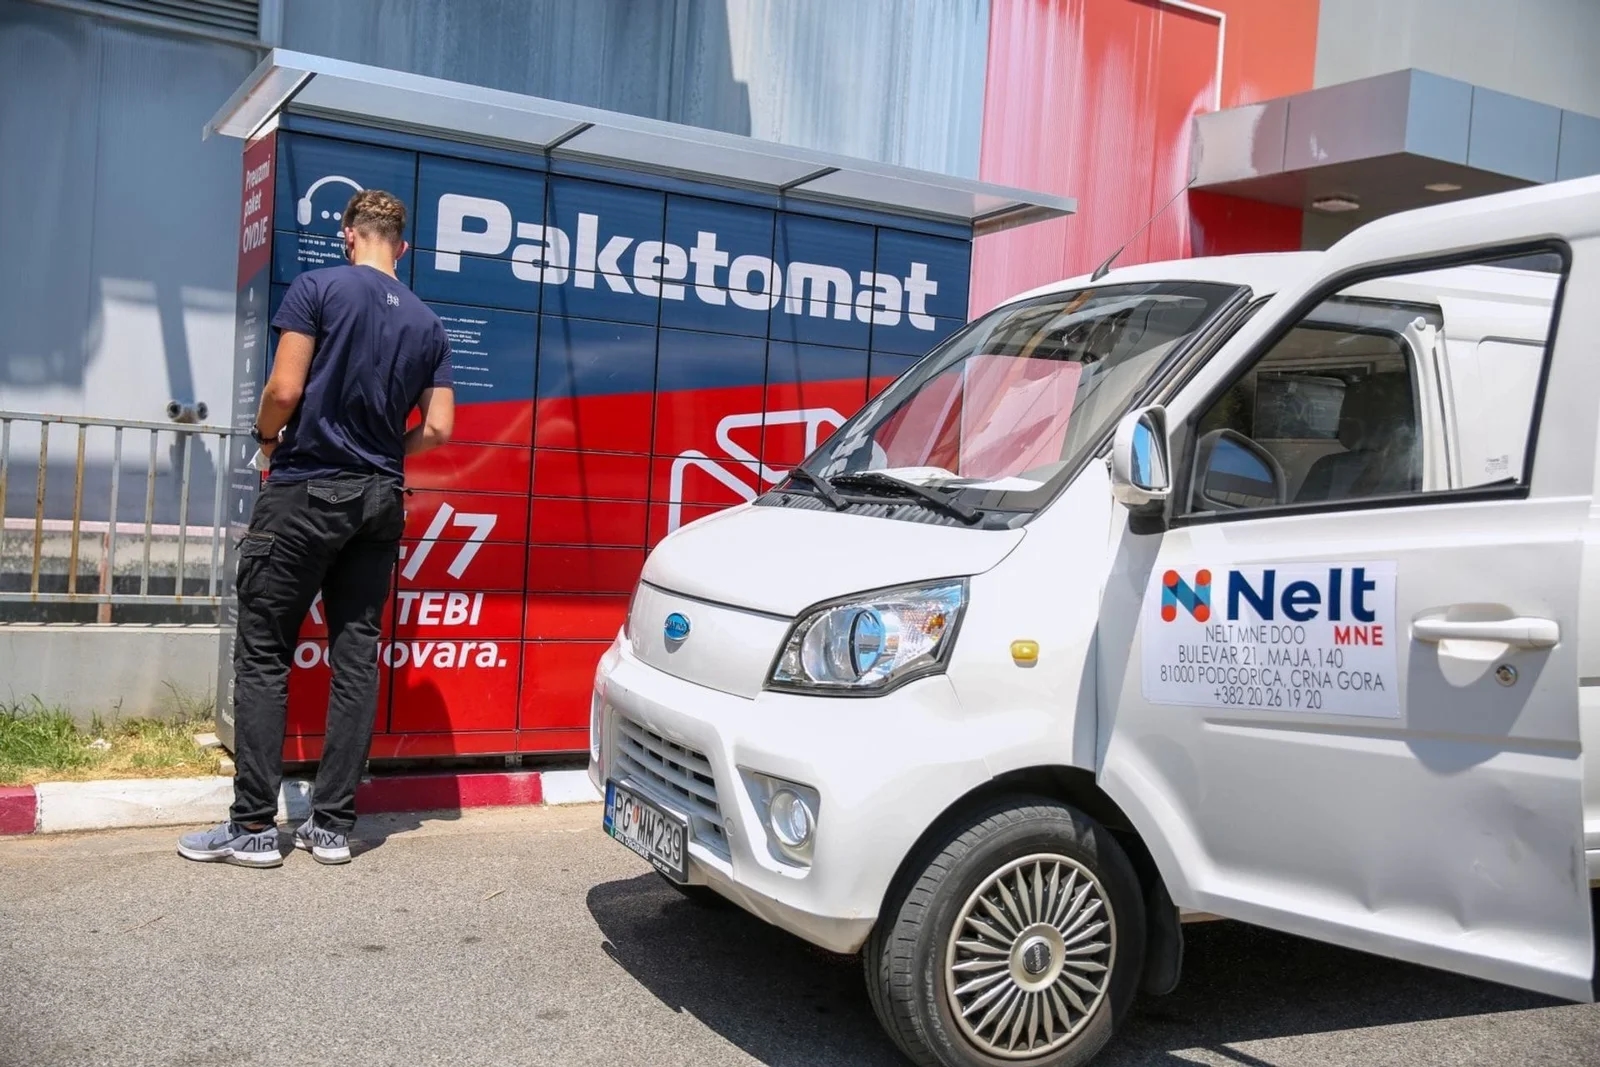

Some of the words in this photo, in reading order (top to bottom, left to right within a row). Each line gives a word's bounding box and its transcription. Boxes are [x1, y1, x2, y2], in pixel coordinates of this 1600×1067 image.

[244, 189, 262, 225] paket
[243, 216, 269, 254] OVDJE
[434, 193, 938, 332] Paketomat
[398, 592, 484, 626] TEBI
[1227, 567, 1376, 623] Nelt
[1205, 624, 1234, 644] NELT
[1237, 624, 1266, 645] MNE
[1271, 625, 1306, 645] DOO
[1334, 625, 1383, 646] MNE
[1178, 644, 1237, 665] BULEVAR
[1160, 664, 1194, 683] 81000
[1198, 665, 1286, 688] PODGORICA,
[1290, 668, 1333, 689] CRNA
[1337, 671, 1385, 692] GORA
[1213, 686, 1243, 705] +382
[1248, 687, 1263, 706] 20
[1267, 688, 1283, 707] 26
[1287, 688, 1301, 708] 19
[1306, 689, 1322, 709] 20
[615, 793, 633, 831] PG
[241, 836, 276, 851] AIR
